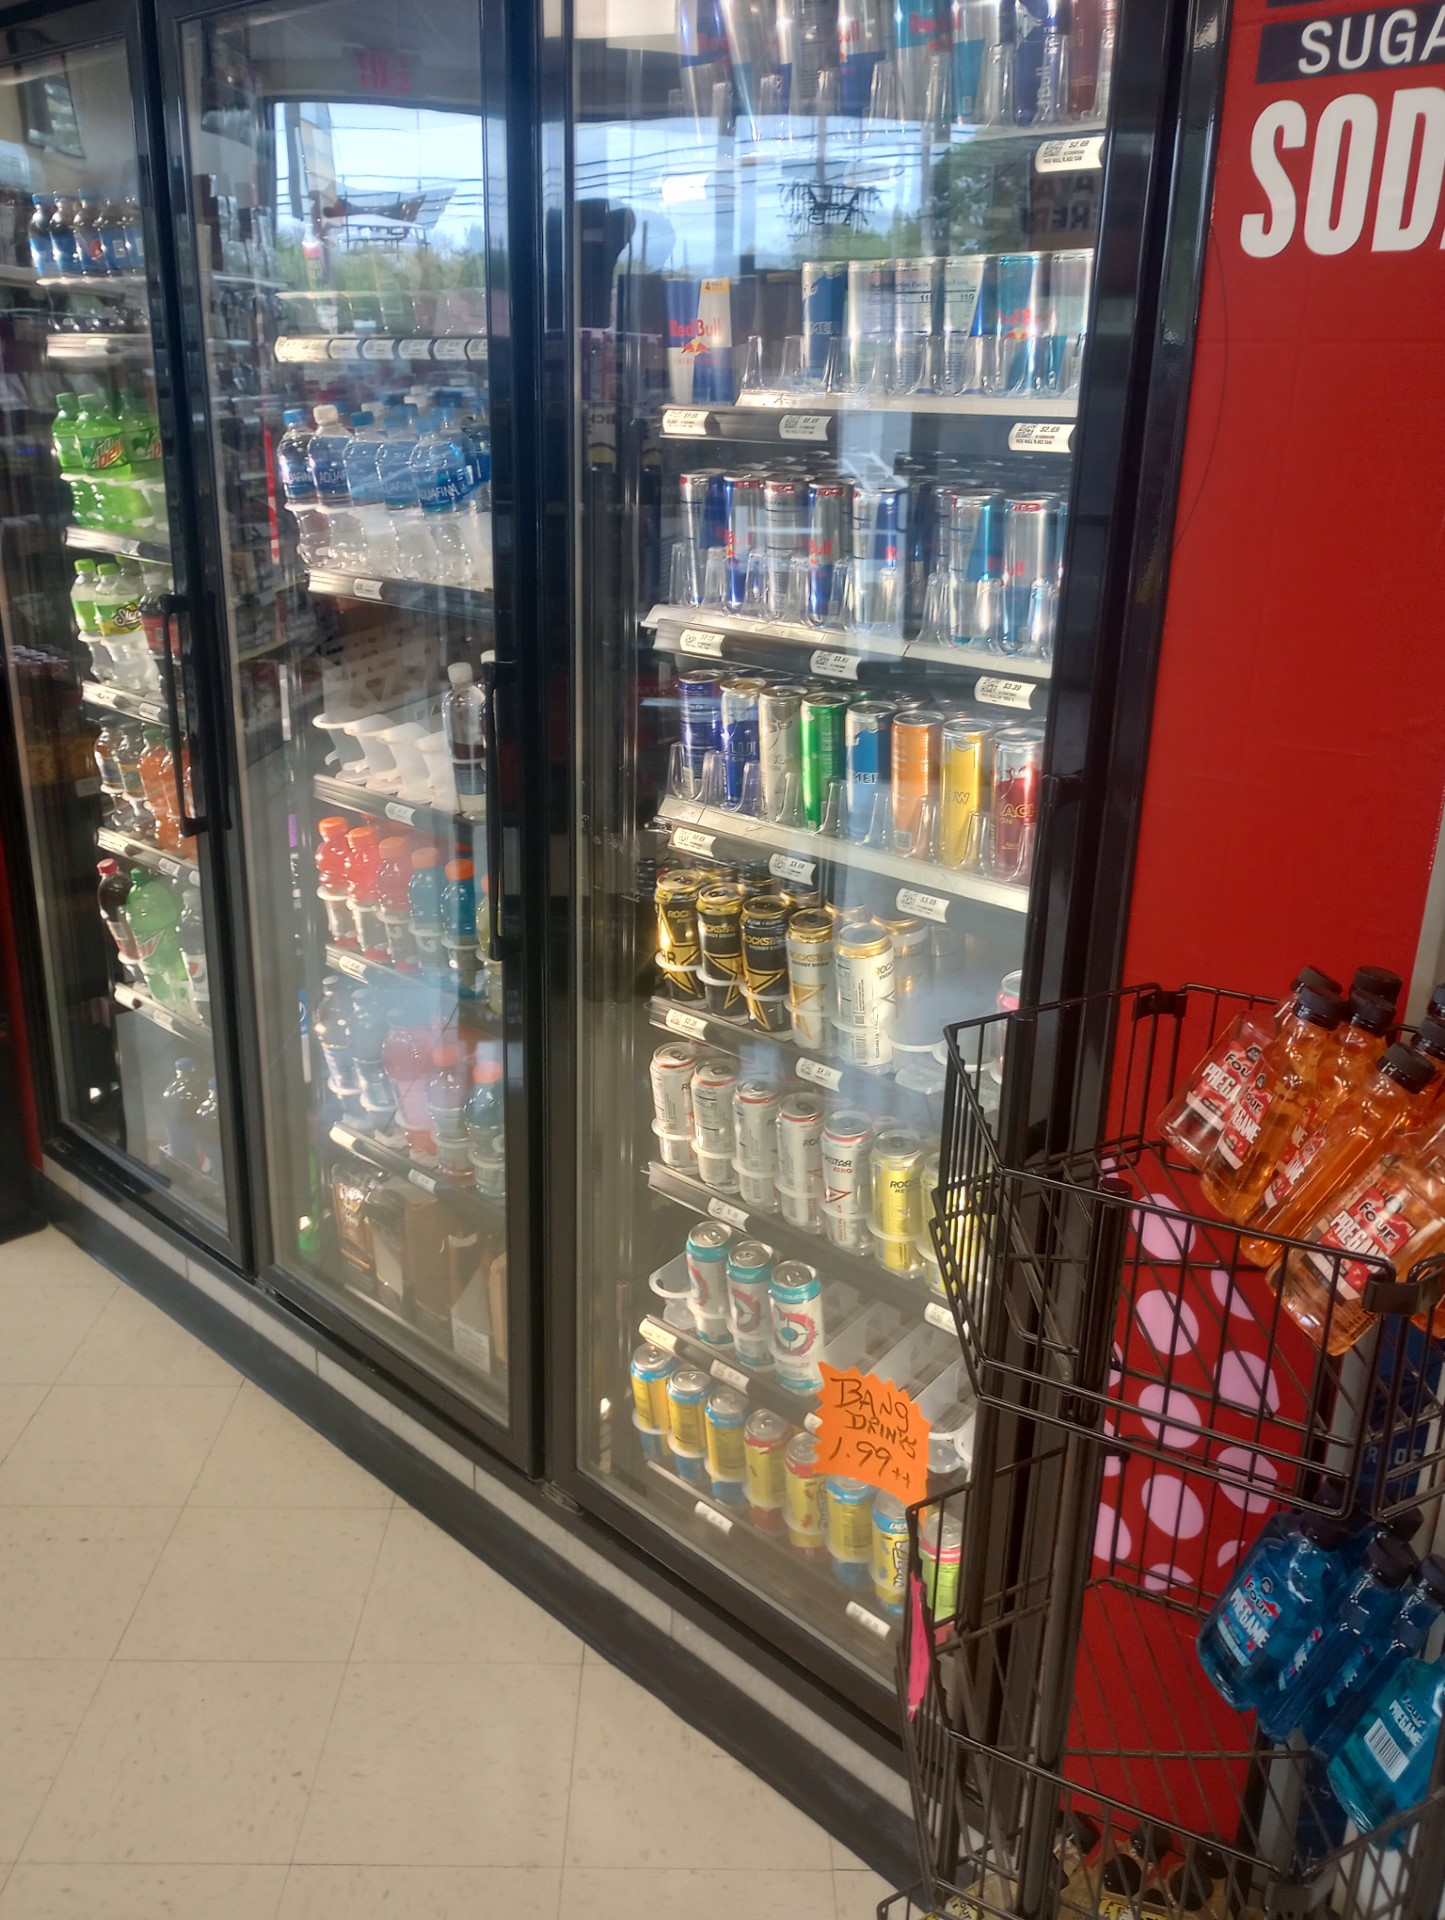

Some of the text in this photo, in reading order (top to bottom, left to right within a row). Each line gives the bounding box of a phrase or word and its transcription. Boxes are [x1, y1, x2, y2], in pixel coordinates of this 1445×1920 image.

[1240, 86, 1445, 258] SOD
[668, 317, 722, 337] Red Bull
